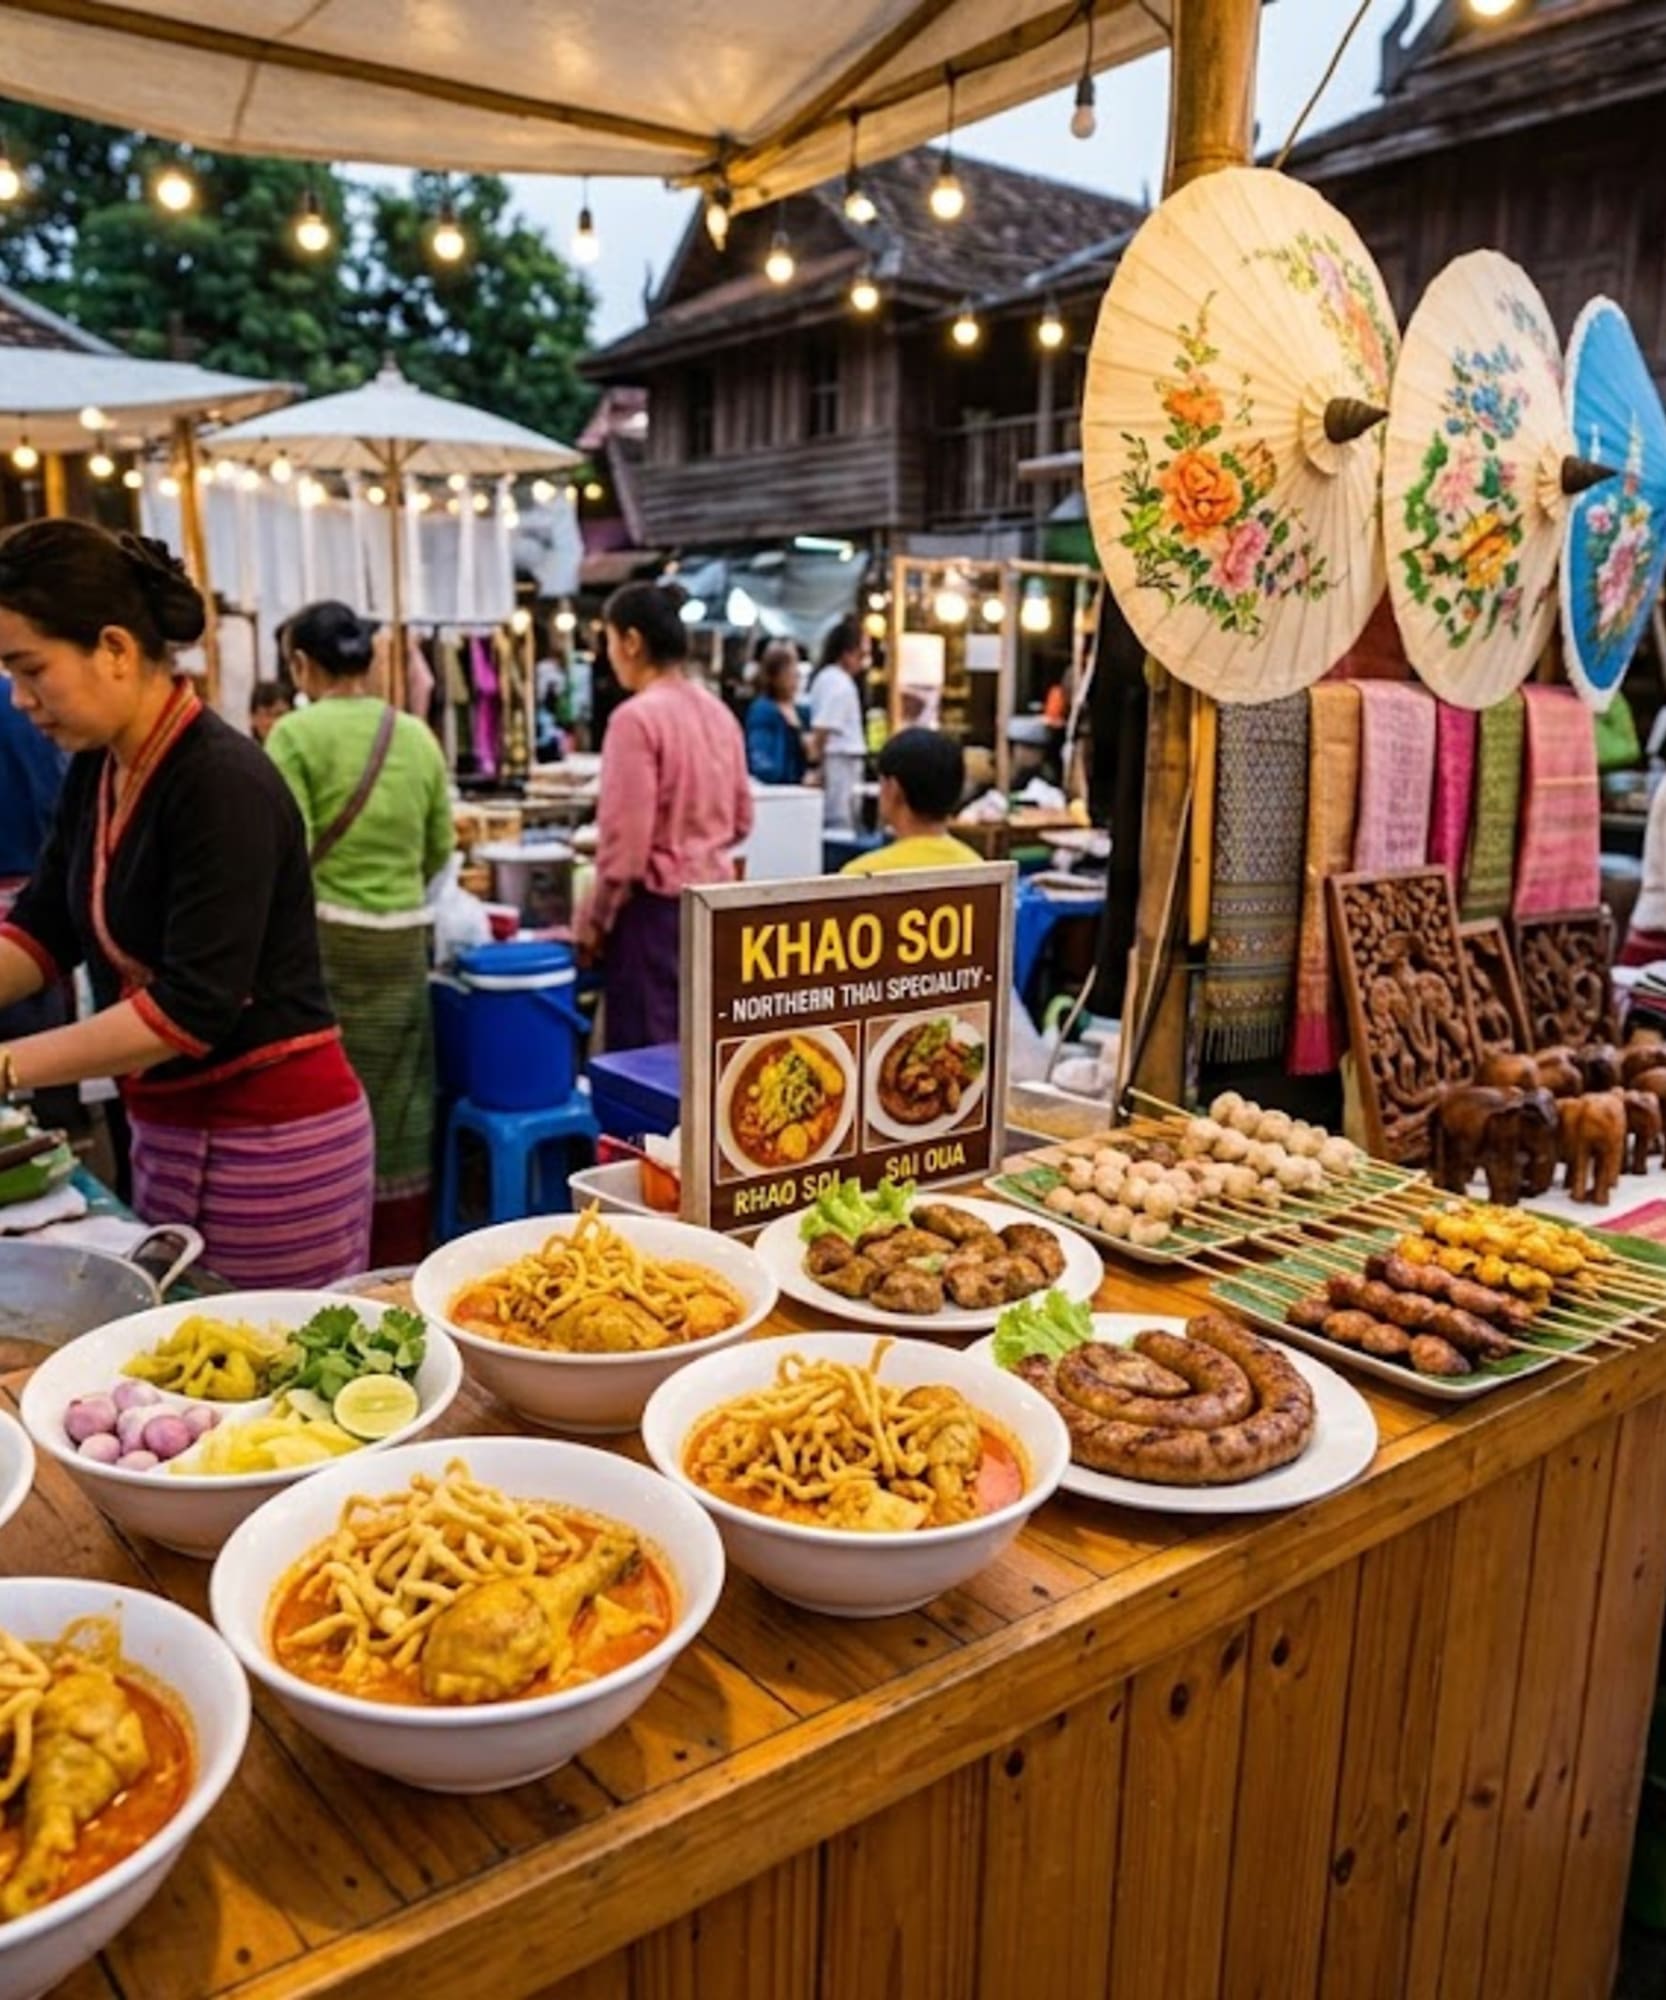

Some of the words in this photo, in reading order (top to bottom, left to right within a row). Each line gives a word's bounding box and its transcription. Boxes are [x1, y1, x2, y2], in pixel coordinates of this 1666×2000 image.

[741, 913, 882, 983] KHAO
[897, 905, 973, 964] SOI
[840, 982, 882, 1009] THAI
